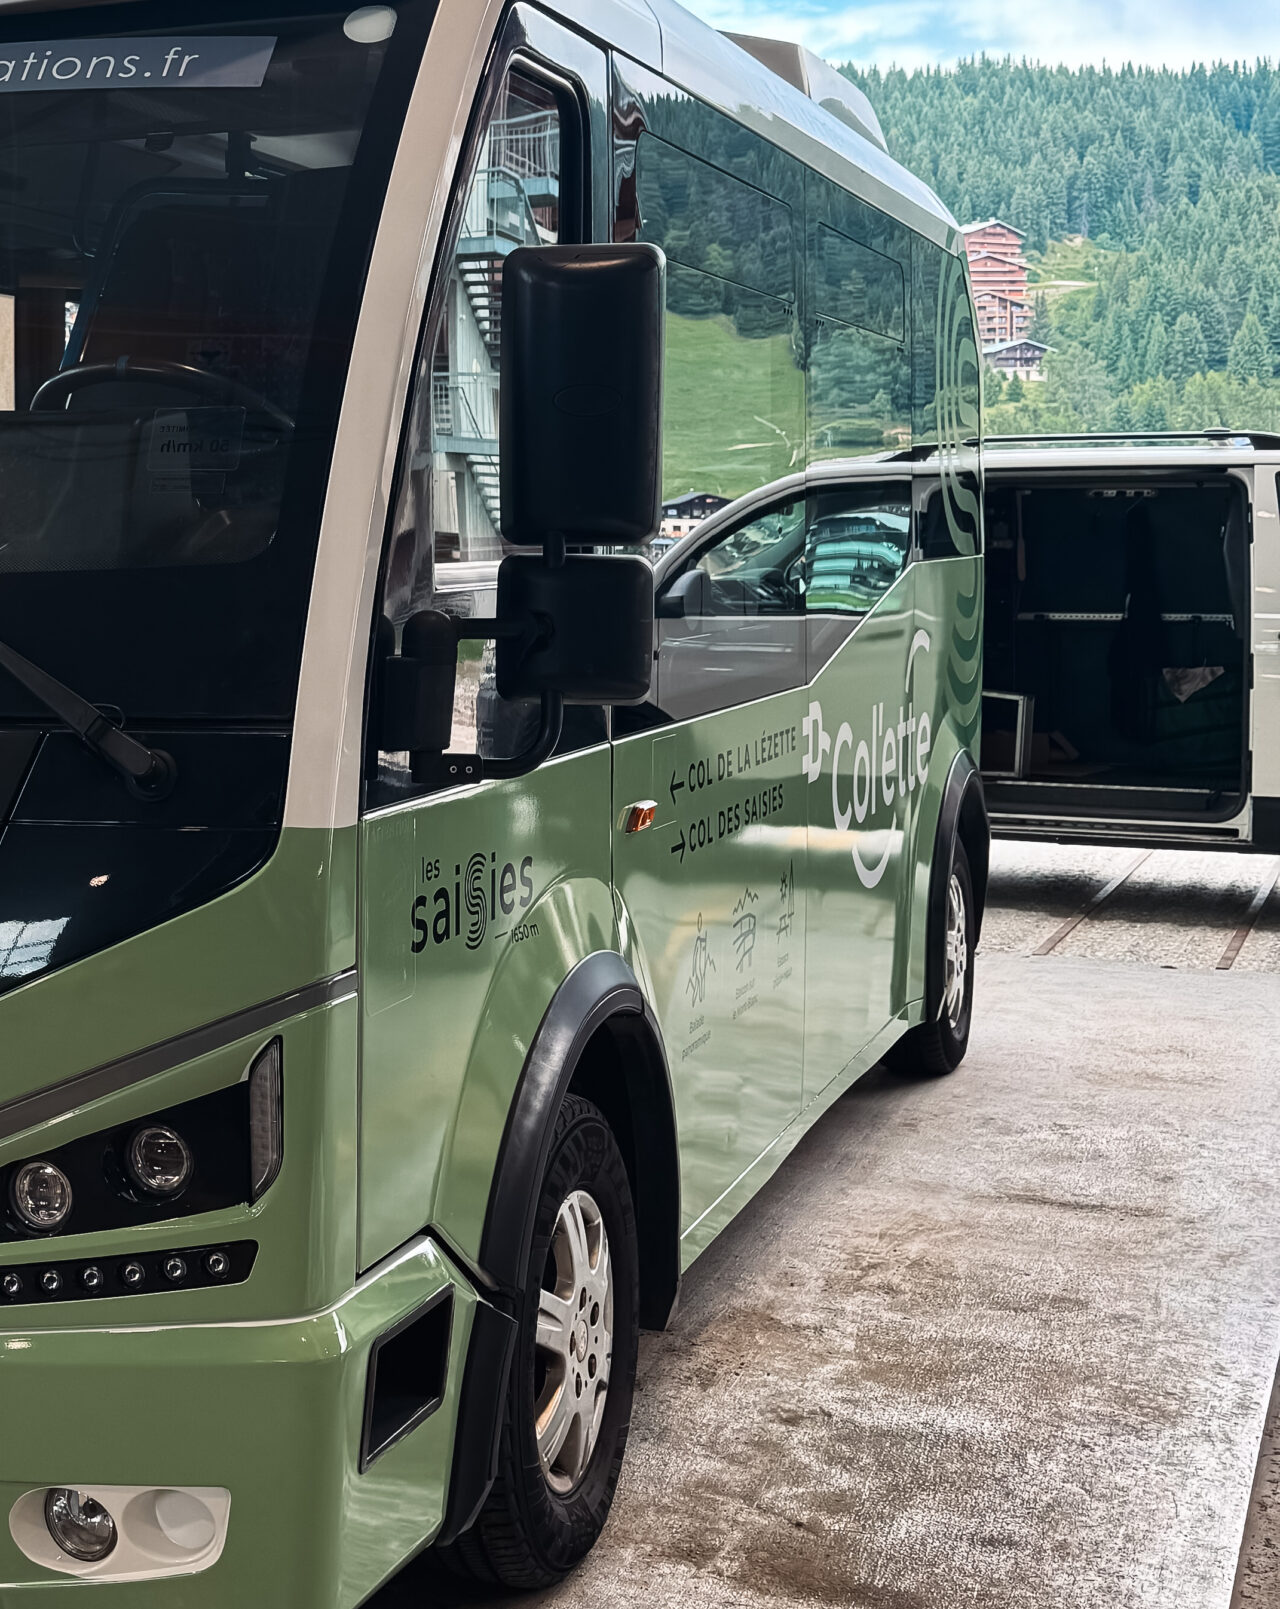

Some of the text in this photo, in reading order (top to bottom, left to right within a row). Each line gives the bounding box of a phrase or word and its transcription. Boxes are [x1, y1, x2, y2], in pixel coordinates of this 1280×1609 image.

[688, 727, 796, 792] COL DE LA LÉZETTE
[831, 702, 931, 832] Col'ette
[689, 783, 784, 852] COL DES SAISIES
[410, 851, 534, 954] saisies
[422, 856, 440, 883] les
